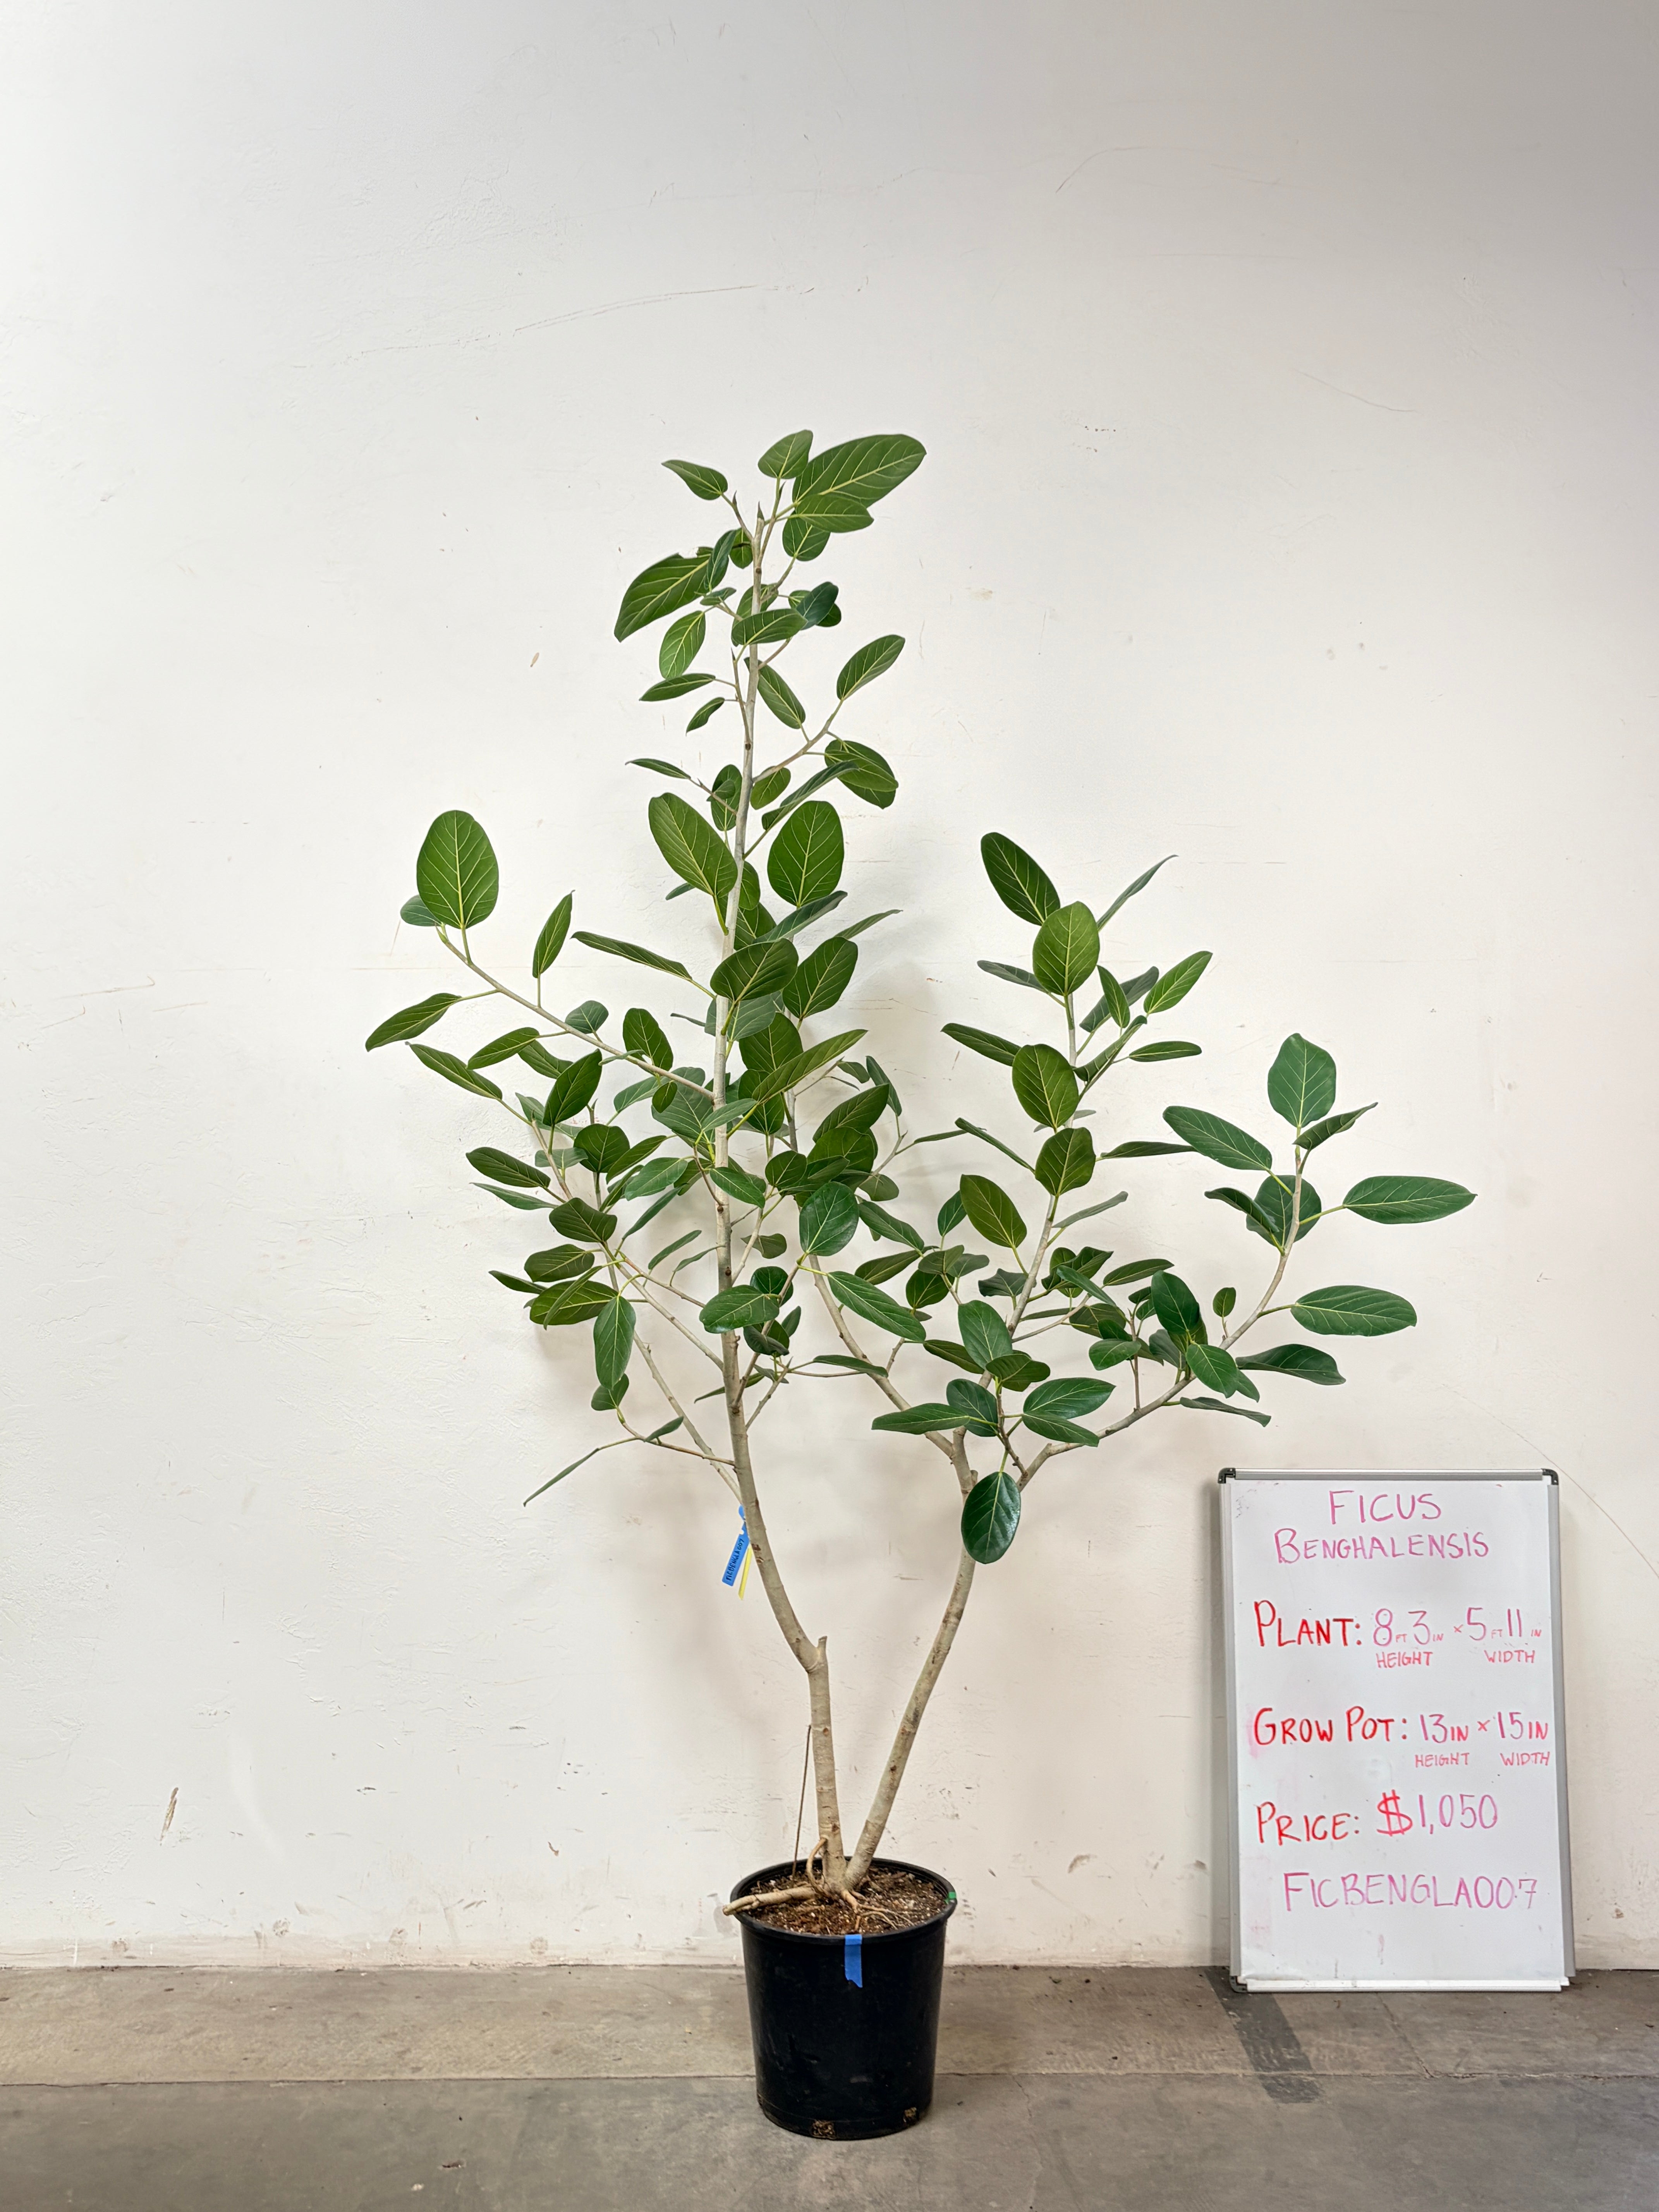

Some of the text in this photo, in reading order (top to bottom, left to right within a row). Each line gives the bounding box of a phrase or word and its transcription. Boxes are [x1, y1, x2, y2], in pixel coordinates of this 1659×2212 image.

[1329, 1490, 1442, 1524] FICUS
[1274, 1528, 1489, 1564] BENGHALENSIS
[1254, 1600, 1362, 1647] PLANT:
[1376, 1650, 1535, 1669] HEIGHT WIDTH
[1253, 1707, 1333, 1745] GROW
[1346, 1705, 1407, 1742] POT:
[1415, 1751, 1550, 1768] HEIGHT WIDTH
[1256, 1789, 1498, 1846] PRICE: $1,050
